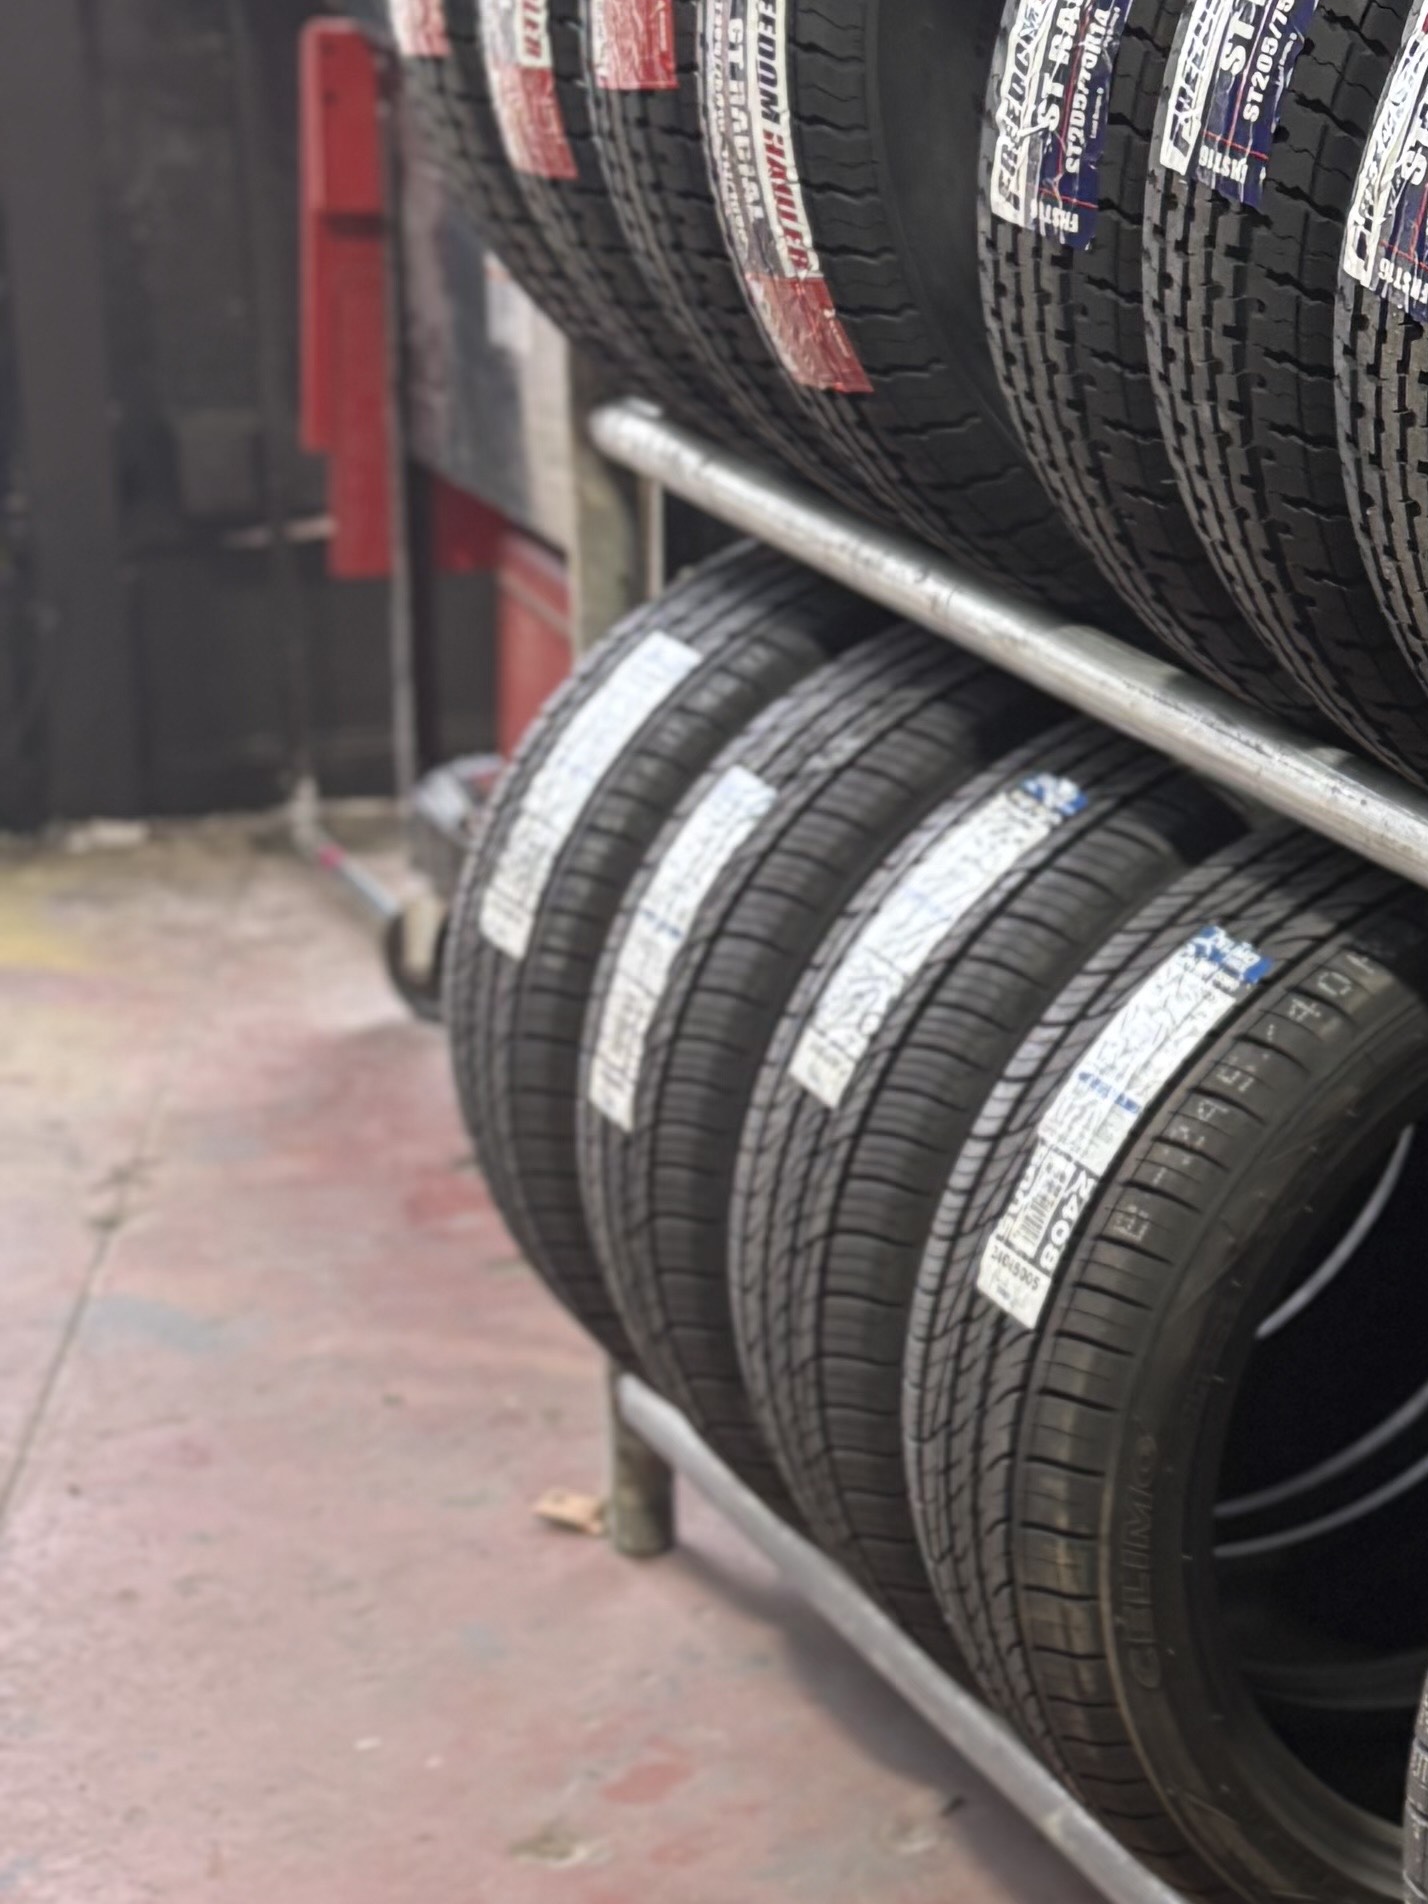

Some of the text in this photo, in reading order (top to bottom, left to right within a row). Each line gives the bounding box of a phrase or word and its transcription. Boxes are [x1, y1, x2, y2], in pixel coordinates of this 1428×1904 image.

[1221, 4, 1255, 76] ST
[1036, 63, 1069, 133] ST
[762, 125, 809, 273] HAULER
